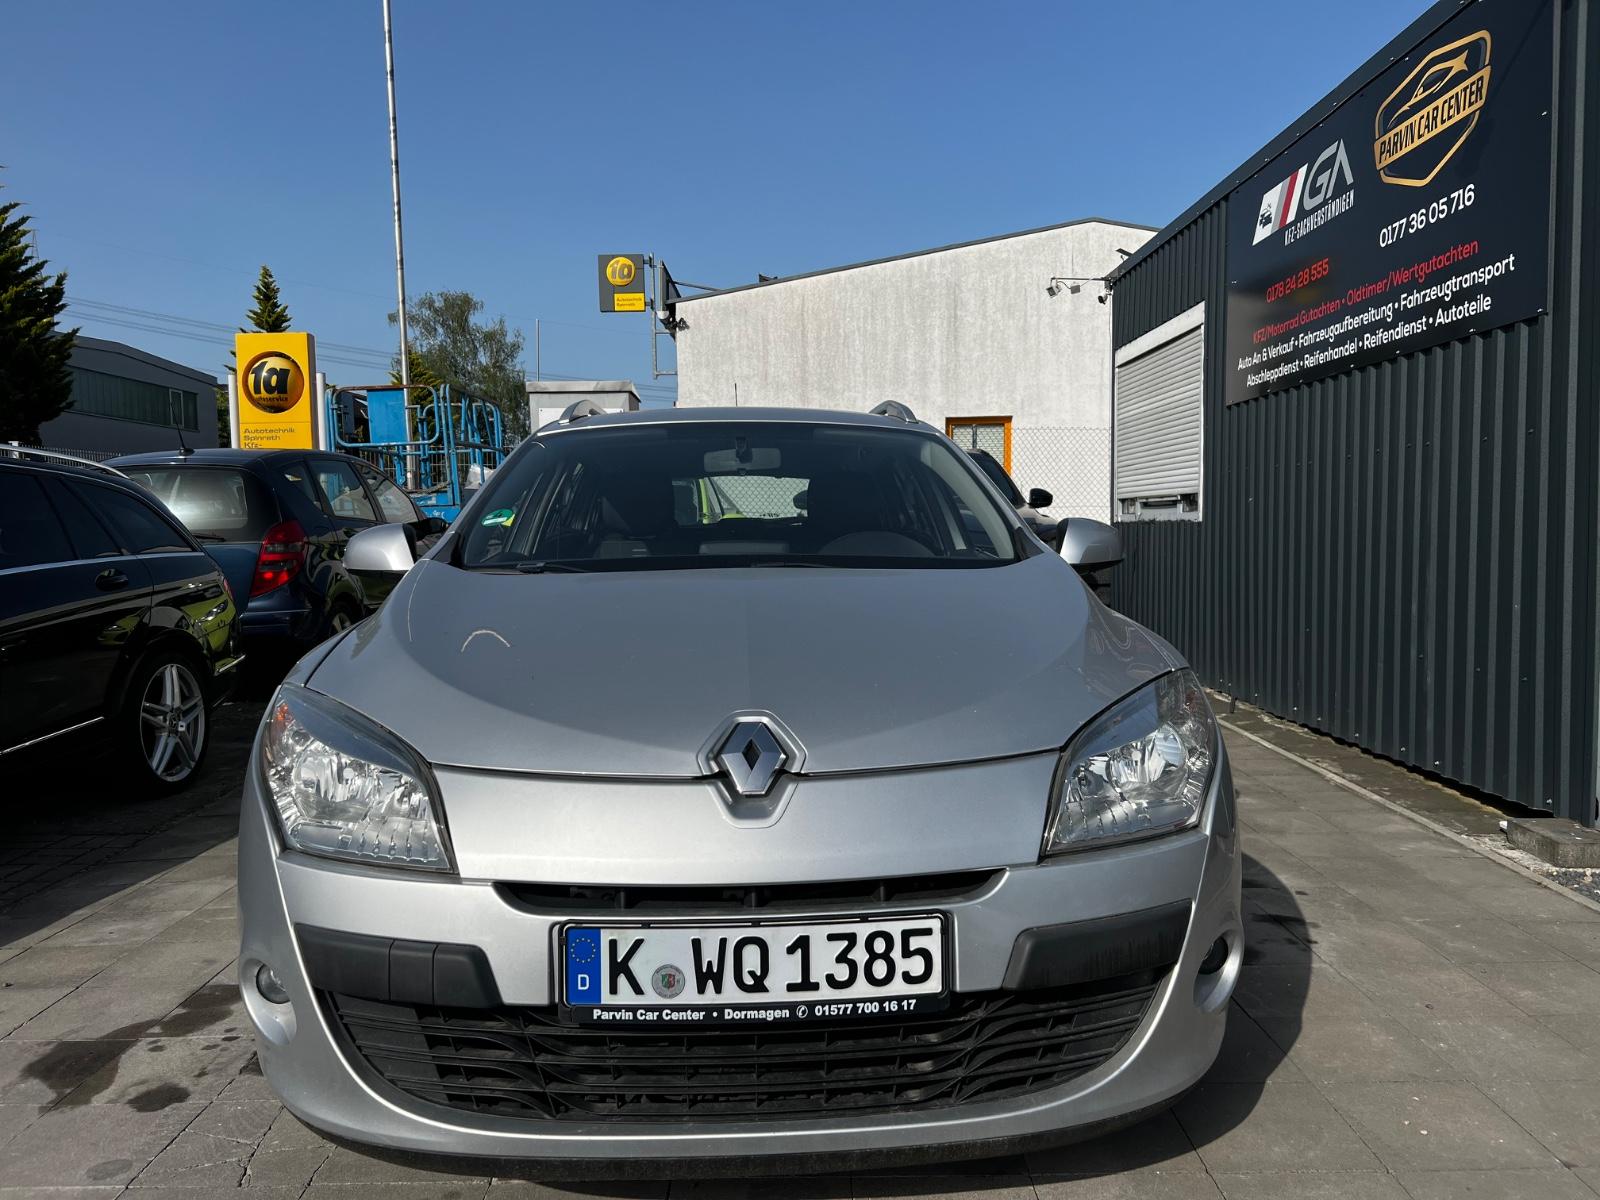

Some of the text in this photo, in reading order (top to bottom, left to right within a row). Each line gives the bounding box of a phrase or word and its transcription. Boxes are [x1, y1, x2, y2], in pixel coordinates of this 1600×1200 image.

[1379, 78, 1484, 163] PARVIN CAR CENTER
[1379, 183, 1475, 247] 0177 36 05 716
[1238, 253, 1515, 371] Auto An & Verkauf Fahrzeugaufbereitung Fahrzeugtransport
[1252, 240, 1479, 344] KFZ/Motorrad Gutachten Oldtimer/Wertgutachten
[1266, 258, 1329, 303] 0178 24 28 555
[1247, 293, 1492, 387] Abschleppdienst Reifenhandel Reifendienst Autoteile
[251, 360, 291, 395] 1a
[577, 973, 590, 990] D
[608, 938, 645, 995] K
[691, 936, 770, 994] WQ
[786, 928, 934, 991] 1385
[592, 999, 917, 1021] Parvin Car Center Dormagen 01577 700 16 17
